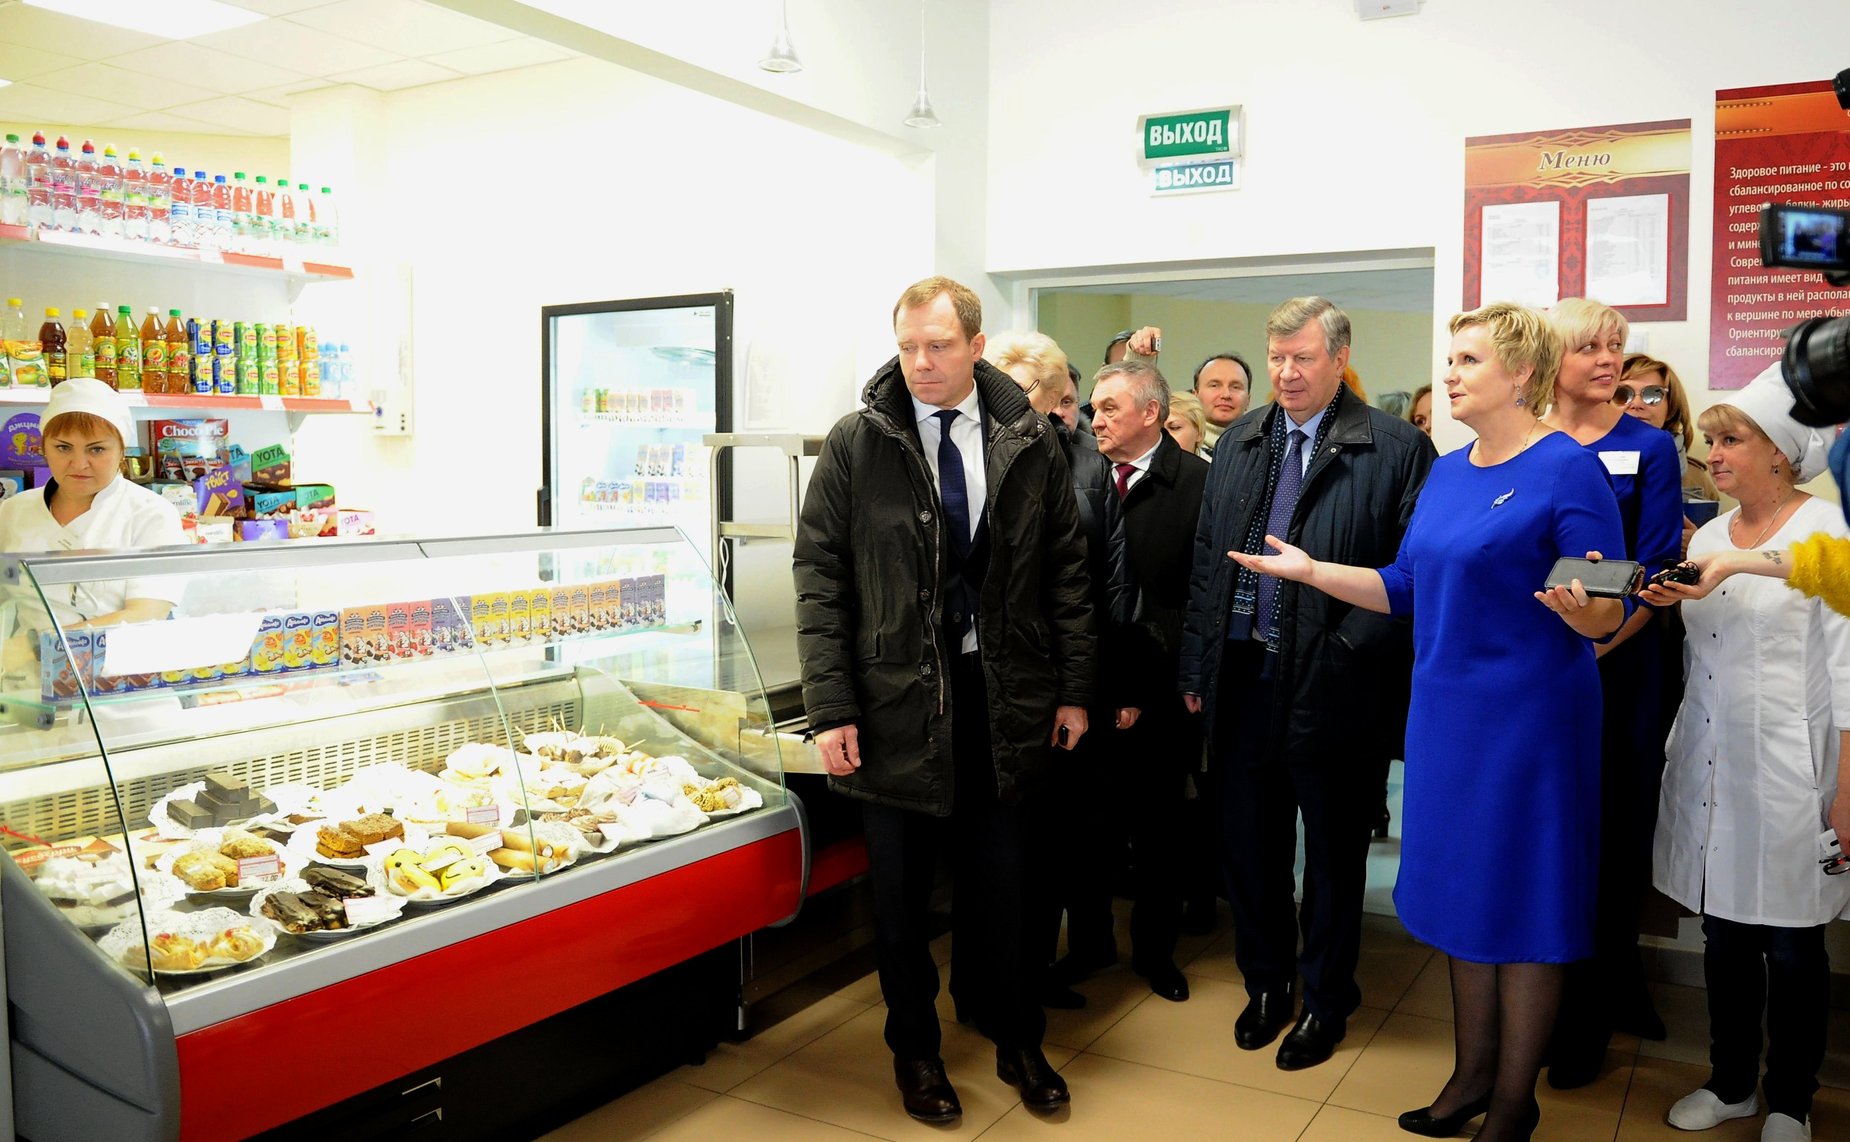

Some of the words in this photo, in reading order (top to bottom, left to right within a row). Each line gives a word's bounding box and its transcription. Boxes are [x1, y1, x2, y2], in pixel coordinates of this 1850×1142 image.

[1149, 119, 1223, 146] ВЫХОД
[1539, 150, 1611, 171] Меню
[1159, 164, 1231, 188] ВЫХОД
[1729, 167, 1778, 180] Здоровое
[1779, 163, 1821, 175] питание
[1829, 161, 1846, 171] это
[1729, 181, 1823, 196] сбалансированное
[1825, 181, 1838, 190] по
[1728, 241, 1735, 250] и
[1727, 275, 1768, 286] питания
[1770, 273, 1802, 284] имеет
[1804, 273, 1823, 284] вид
[1727, 292, 1776, 305] продукты
[1777, 292, 1784, 301] в
[1786, 289, 1805, 300] ней
[1727, 312, 1733, 321] к
[1735, 310, 1780, 323] вершине
[1782, 310, 1794, 319] по
[1796, 308, 1823, 320] мере
[1728, 327, 1784, 341] Ориентиру
[256, 447, 286, 463] YOTA
[257, 496, 280, 509] YOTA
